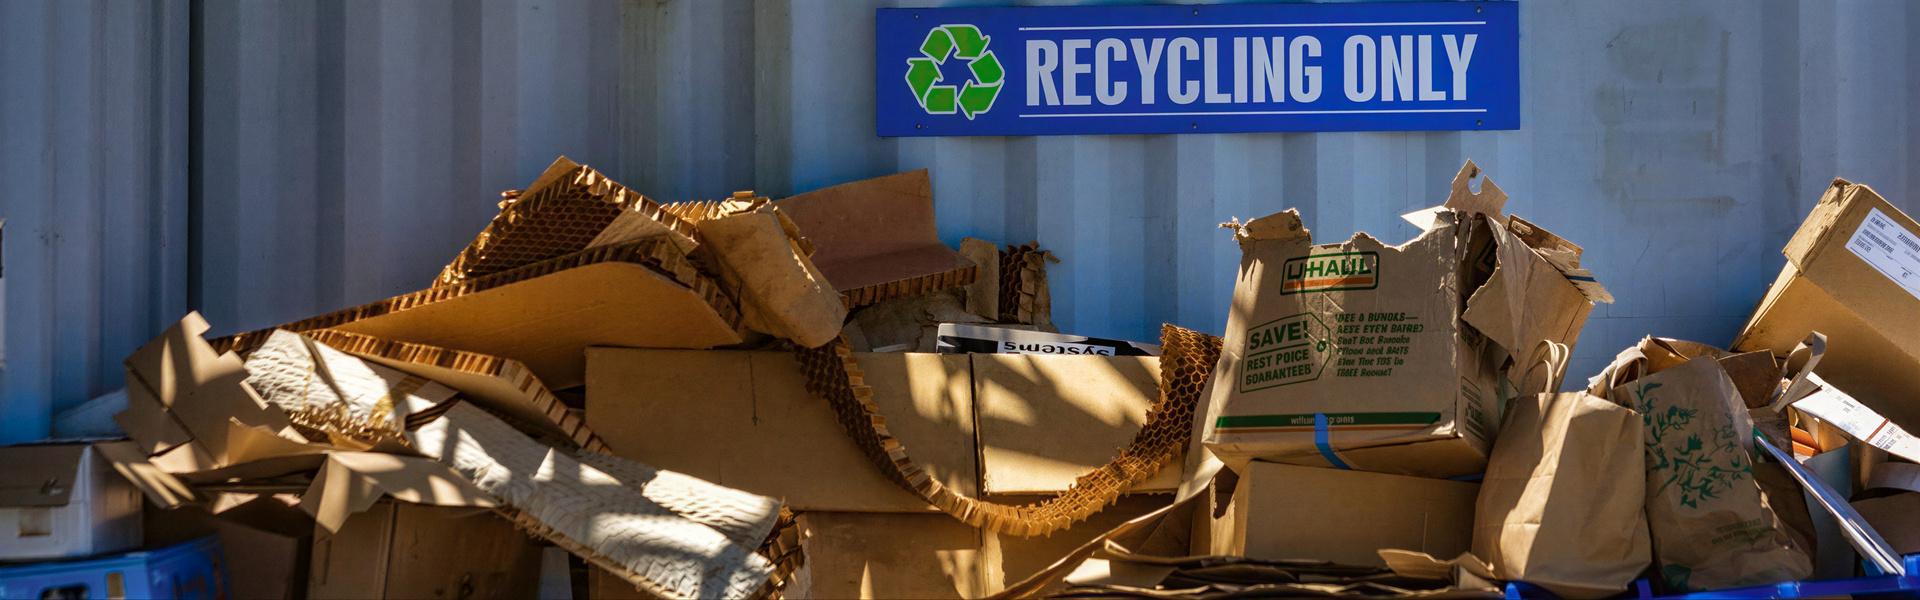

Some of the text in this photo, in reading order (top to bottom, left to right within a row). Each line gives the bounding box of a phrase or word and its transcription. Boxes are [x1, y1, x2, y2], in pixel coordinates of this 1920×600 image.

[1025, 34, 1478, 106] RECYCLING ONLY
[1003, 341, 1110, 356] systems
[1249, 320, 1309, 350] SAVE!
